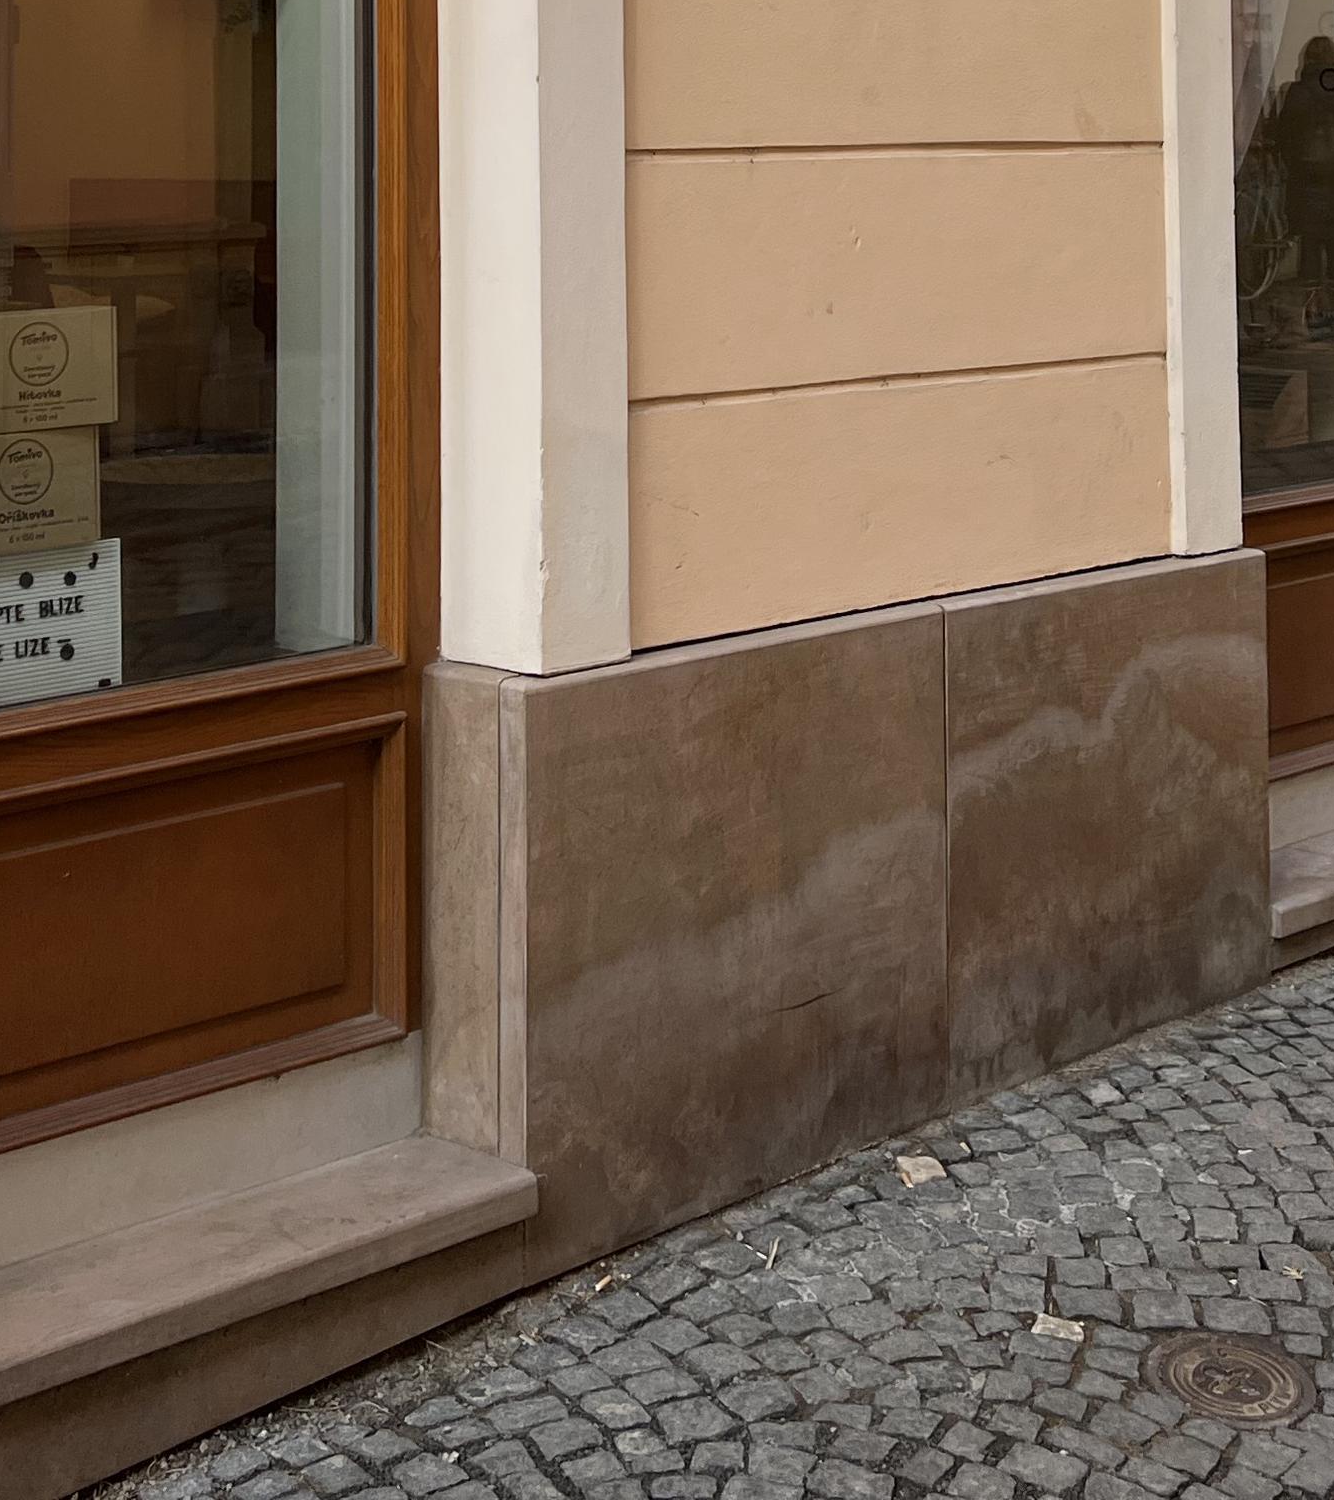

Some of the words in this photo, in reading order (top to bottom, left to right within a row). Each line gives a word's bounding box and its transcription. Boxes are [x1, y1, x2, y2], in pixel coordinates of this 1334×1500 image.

[20, 330, 59, 346] Tomivo
[7, 448, 43, 464] Tomivo
[38, 594, 85, 620] BLIZE
[14, 636, 51, 659] LIZE
